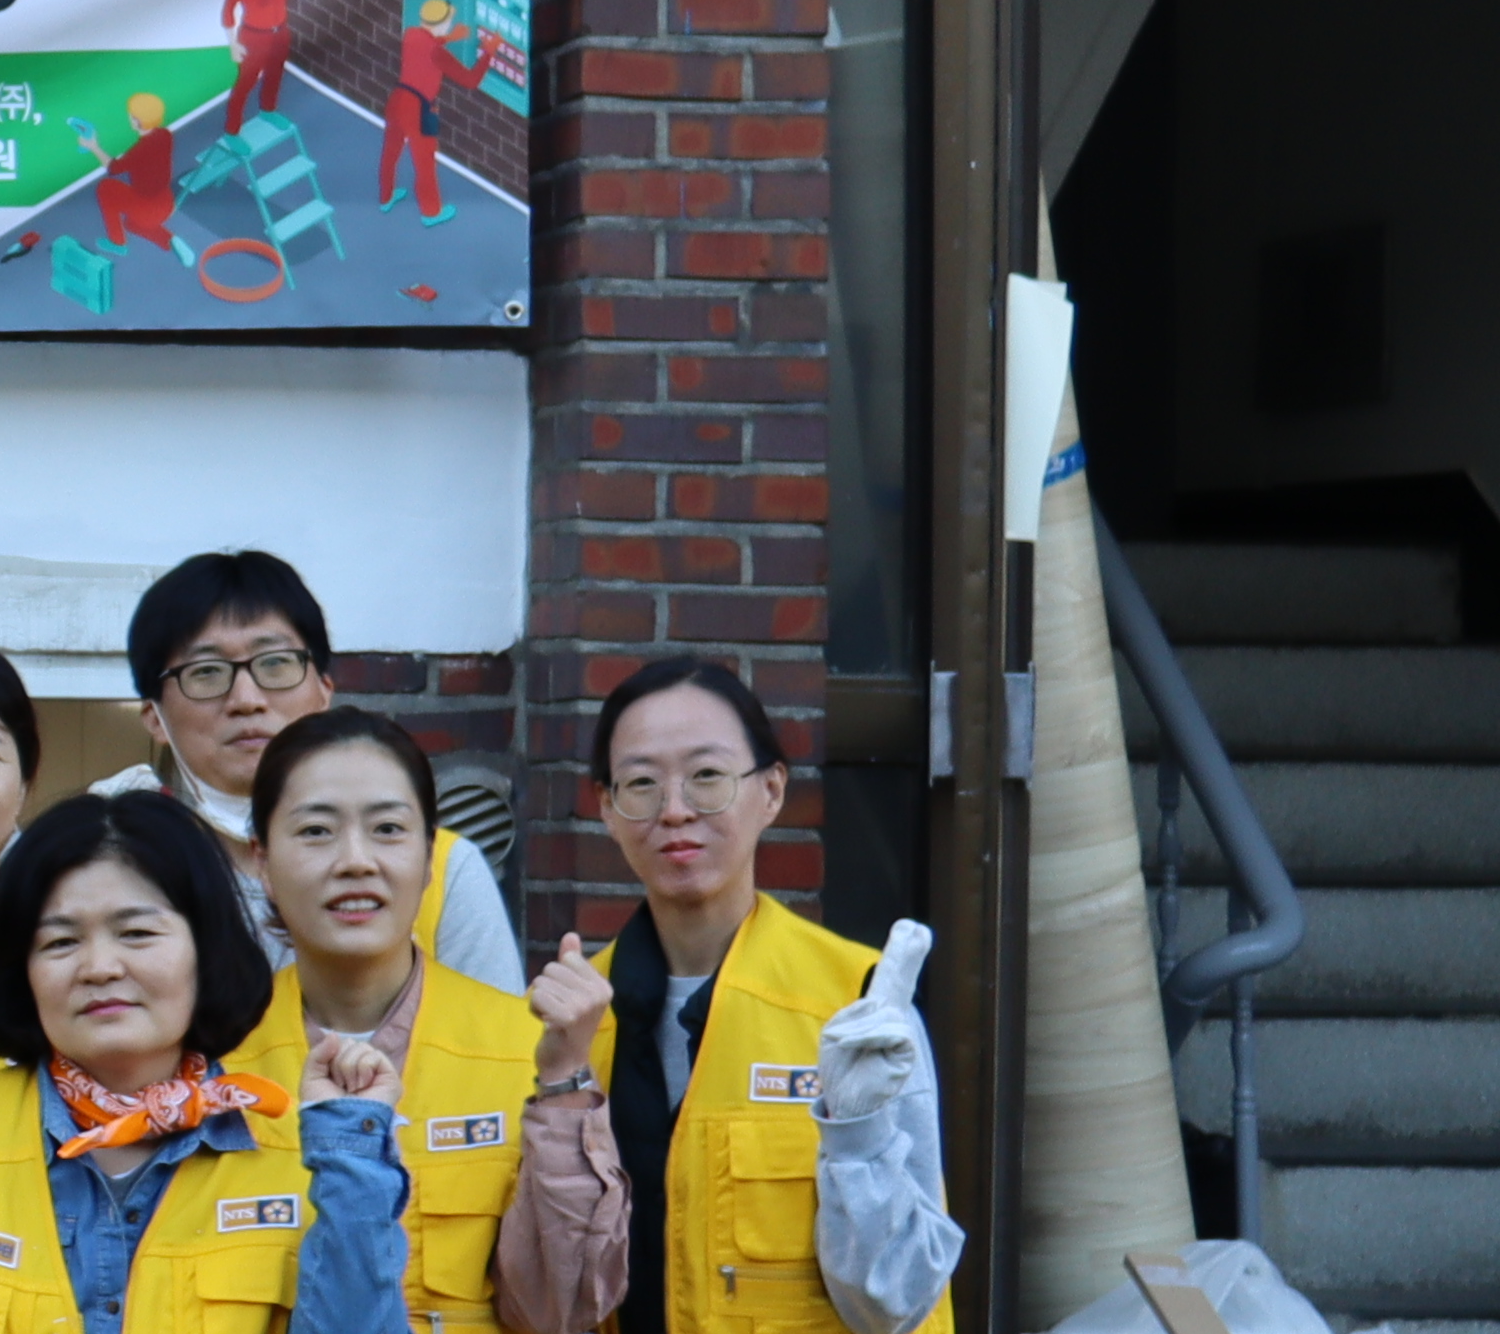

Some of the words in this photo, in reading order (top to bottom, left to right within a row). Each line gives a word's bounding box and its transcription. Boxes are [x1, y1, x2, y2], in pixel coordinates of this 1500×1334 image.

[757, 1076, 787, 1090] NTS
[434, 1126, 464, 1140] NTS
[223, 1207, 256, 1221] NTS
